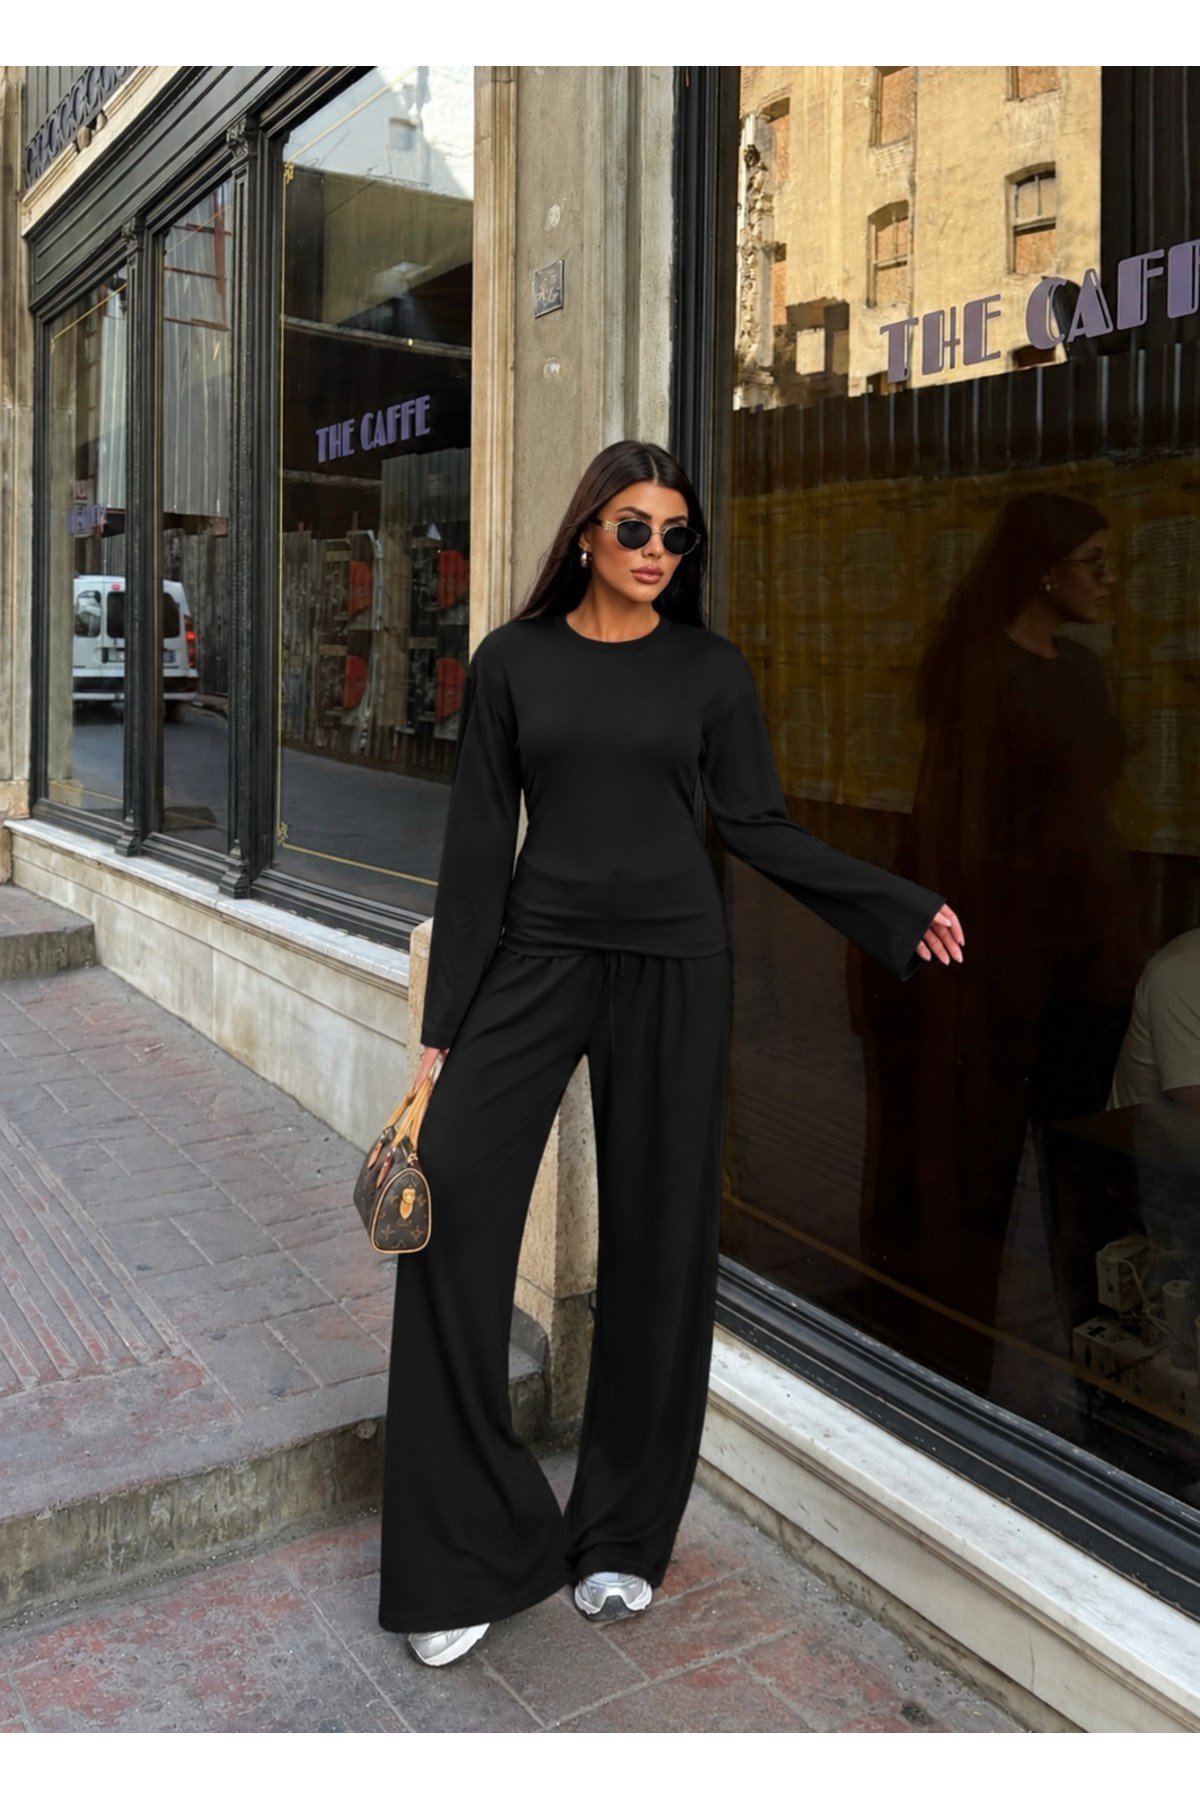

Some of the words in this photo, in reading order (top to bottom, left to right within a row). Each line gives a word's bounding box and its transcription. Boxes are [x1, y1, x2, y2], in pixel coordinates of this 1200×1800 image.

[880, 293, 1001, 383] THE
[315, 418, 355, 463] THE
[360, 394, 431, 451] CAFFE
